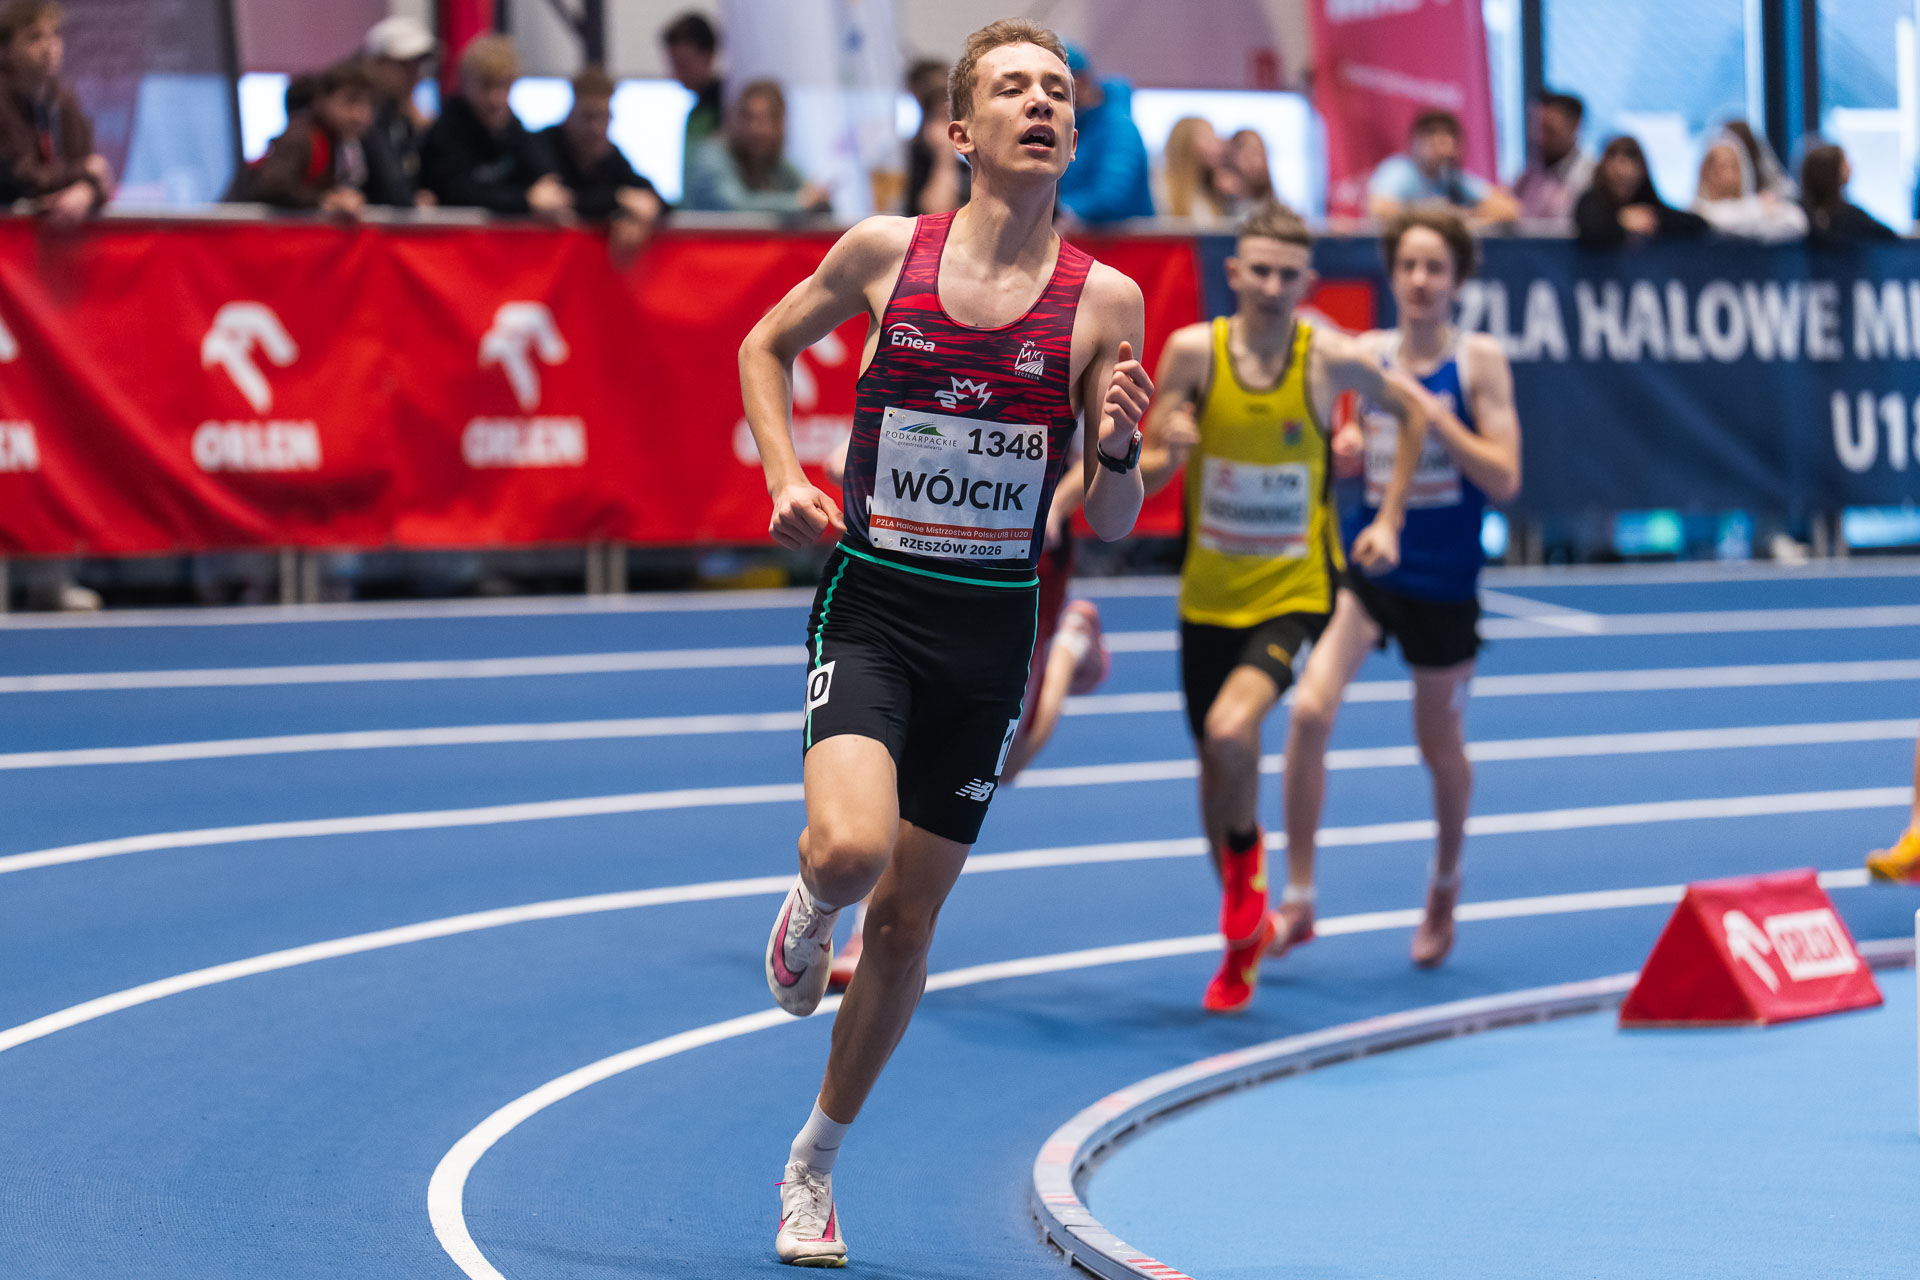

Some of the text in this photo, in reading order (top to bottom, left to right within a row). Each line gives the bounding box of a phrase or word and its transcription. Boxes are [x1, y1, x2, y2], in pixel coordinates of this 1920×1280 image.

[1455, 279, 1571, 361] ZLA
[1574, 278, 1843, 363] HALOWE
[891, 331, 936, 352] Enea
[885, 431, 957, 447] PODKARPACKIE
[967, 428, 1044, 461] 1348
[891, 468, 1029, 511] WÓJCIK
[876, 518, 895, 528] PZLA
[896, 521, 925, 533] Halowe
[926, 526, 972, 537] Mistrzostwa
[973, 530, 996, 539] Polski
[997, 531, 1009, 539] U18
[1014, 530, 1029, 538] U20
[899, 537, 1002, 556] RZESZÓW 2026
